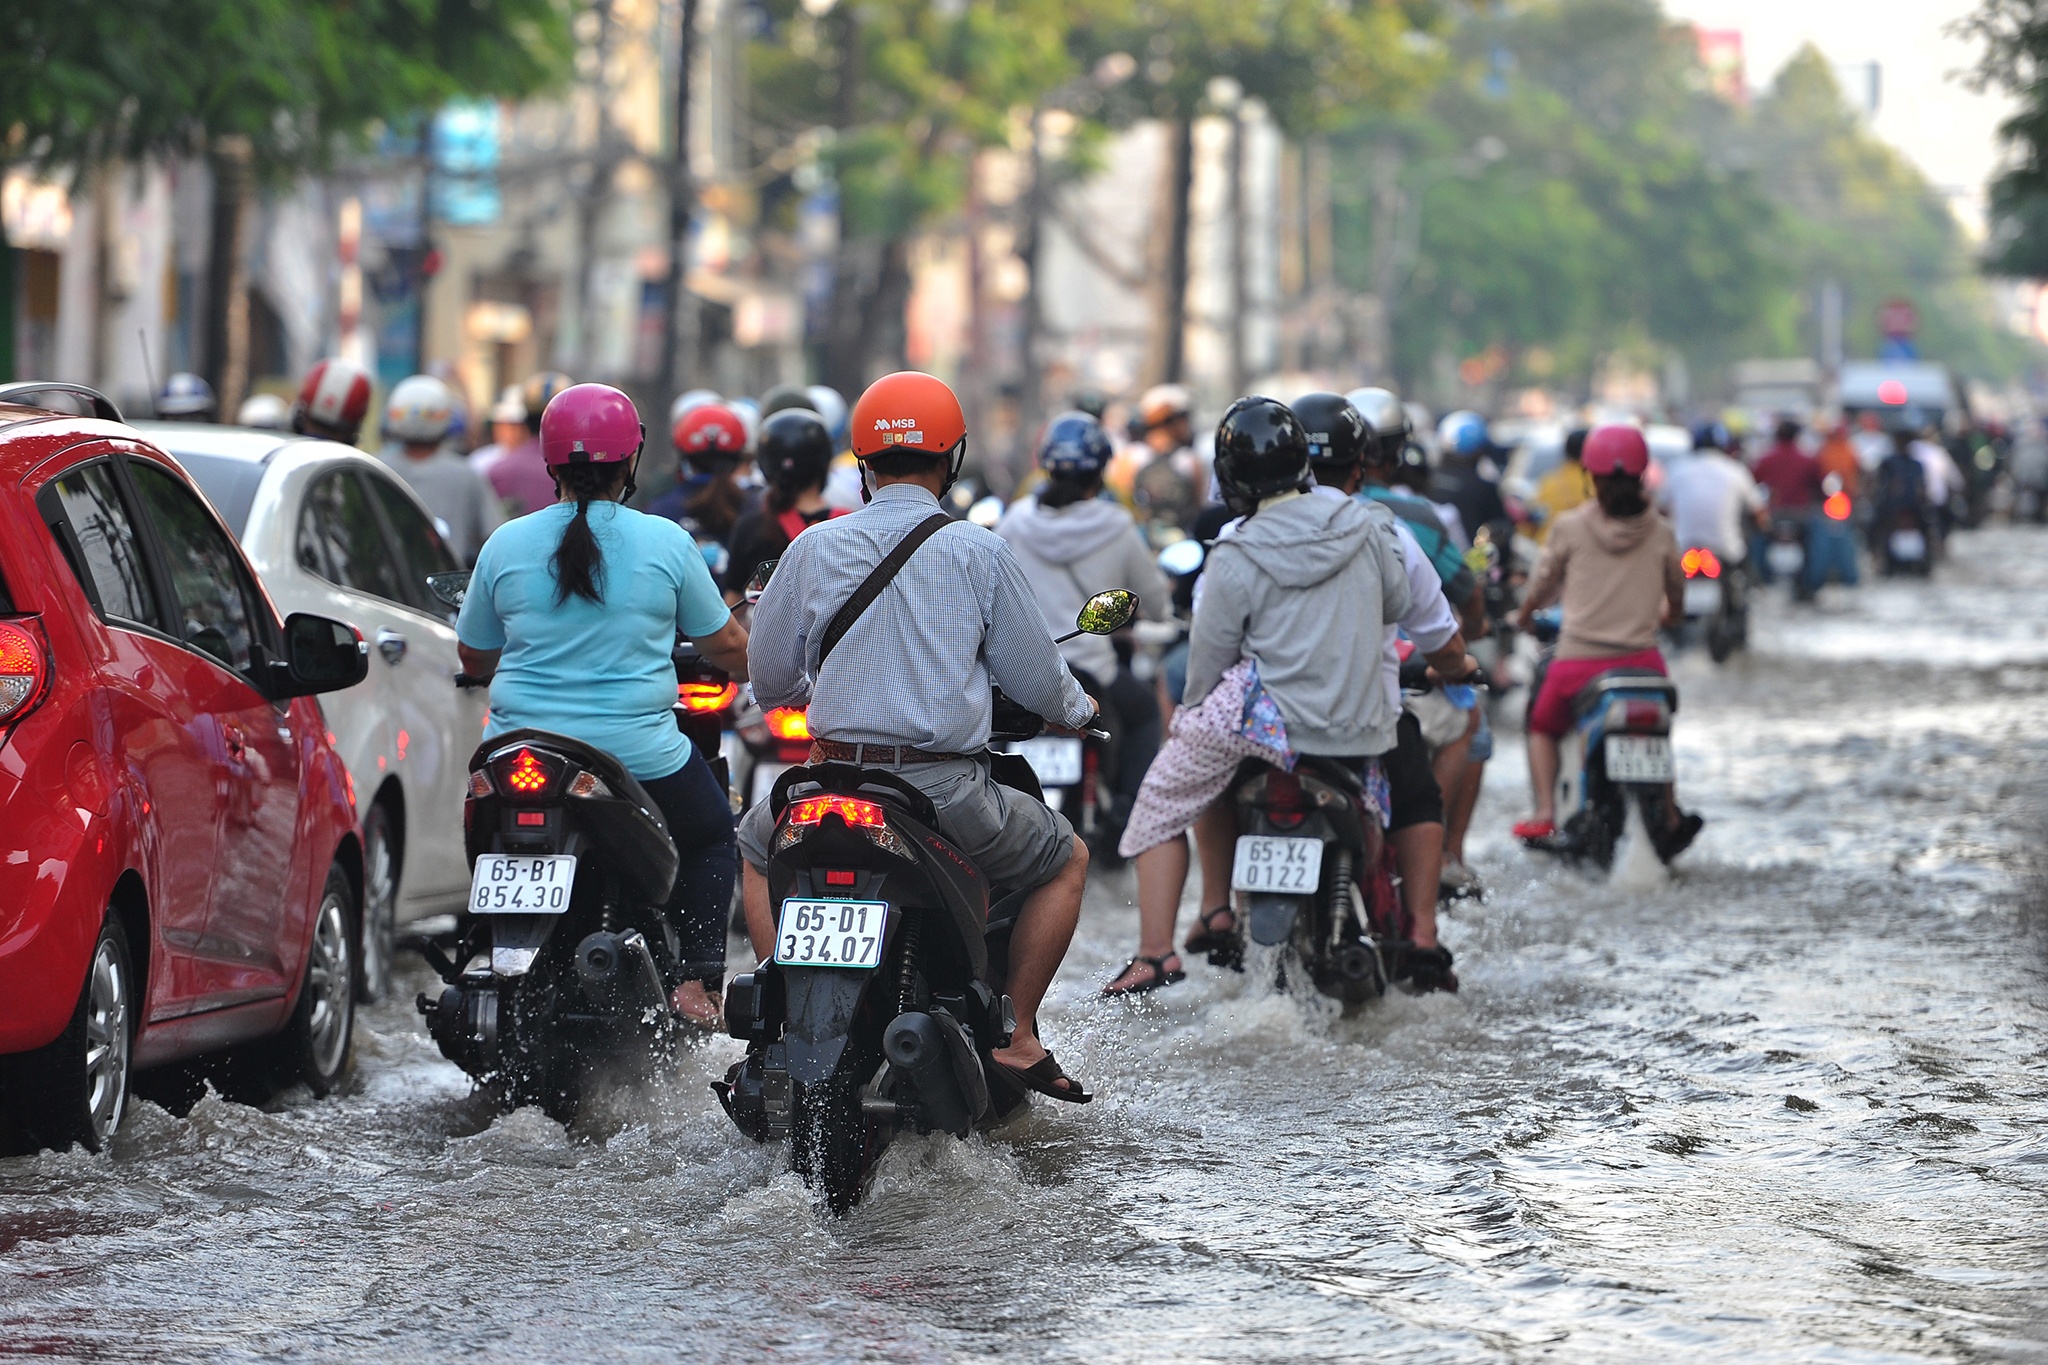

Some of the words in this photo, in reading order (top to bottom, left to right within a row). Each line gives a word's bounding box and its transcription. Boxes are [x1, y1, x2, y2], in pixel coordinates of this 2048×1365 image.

[891, 418, 916, 429] MSB
[1250, 841, 1307, 863] 65-X4
[490, 859, 557, 882] 65-B1
[1247, 865, 1306, 887] 0122
[476, 885, 565, 908] 854.30
[795, 905, 868, 933] 65-D1
[781, 934, 876, 963] 334.07
